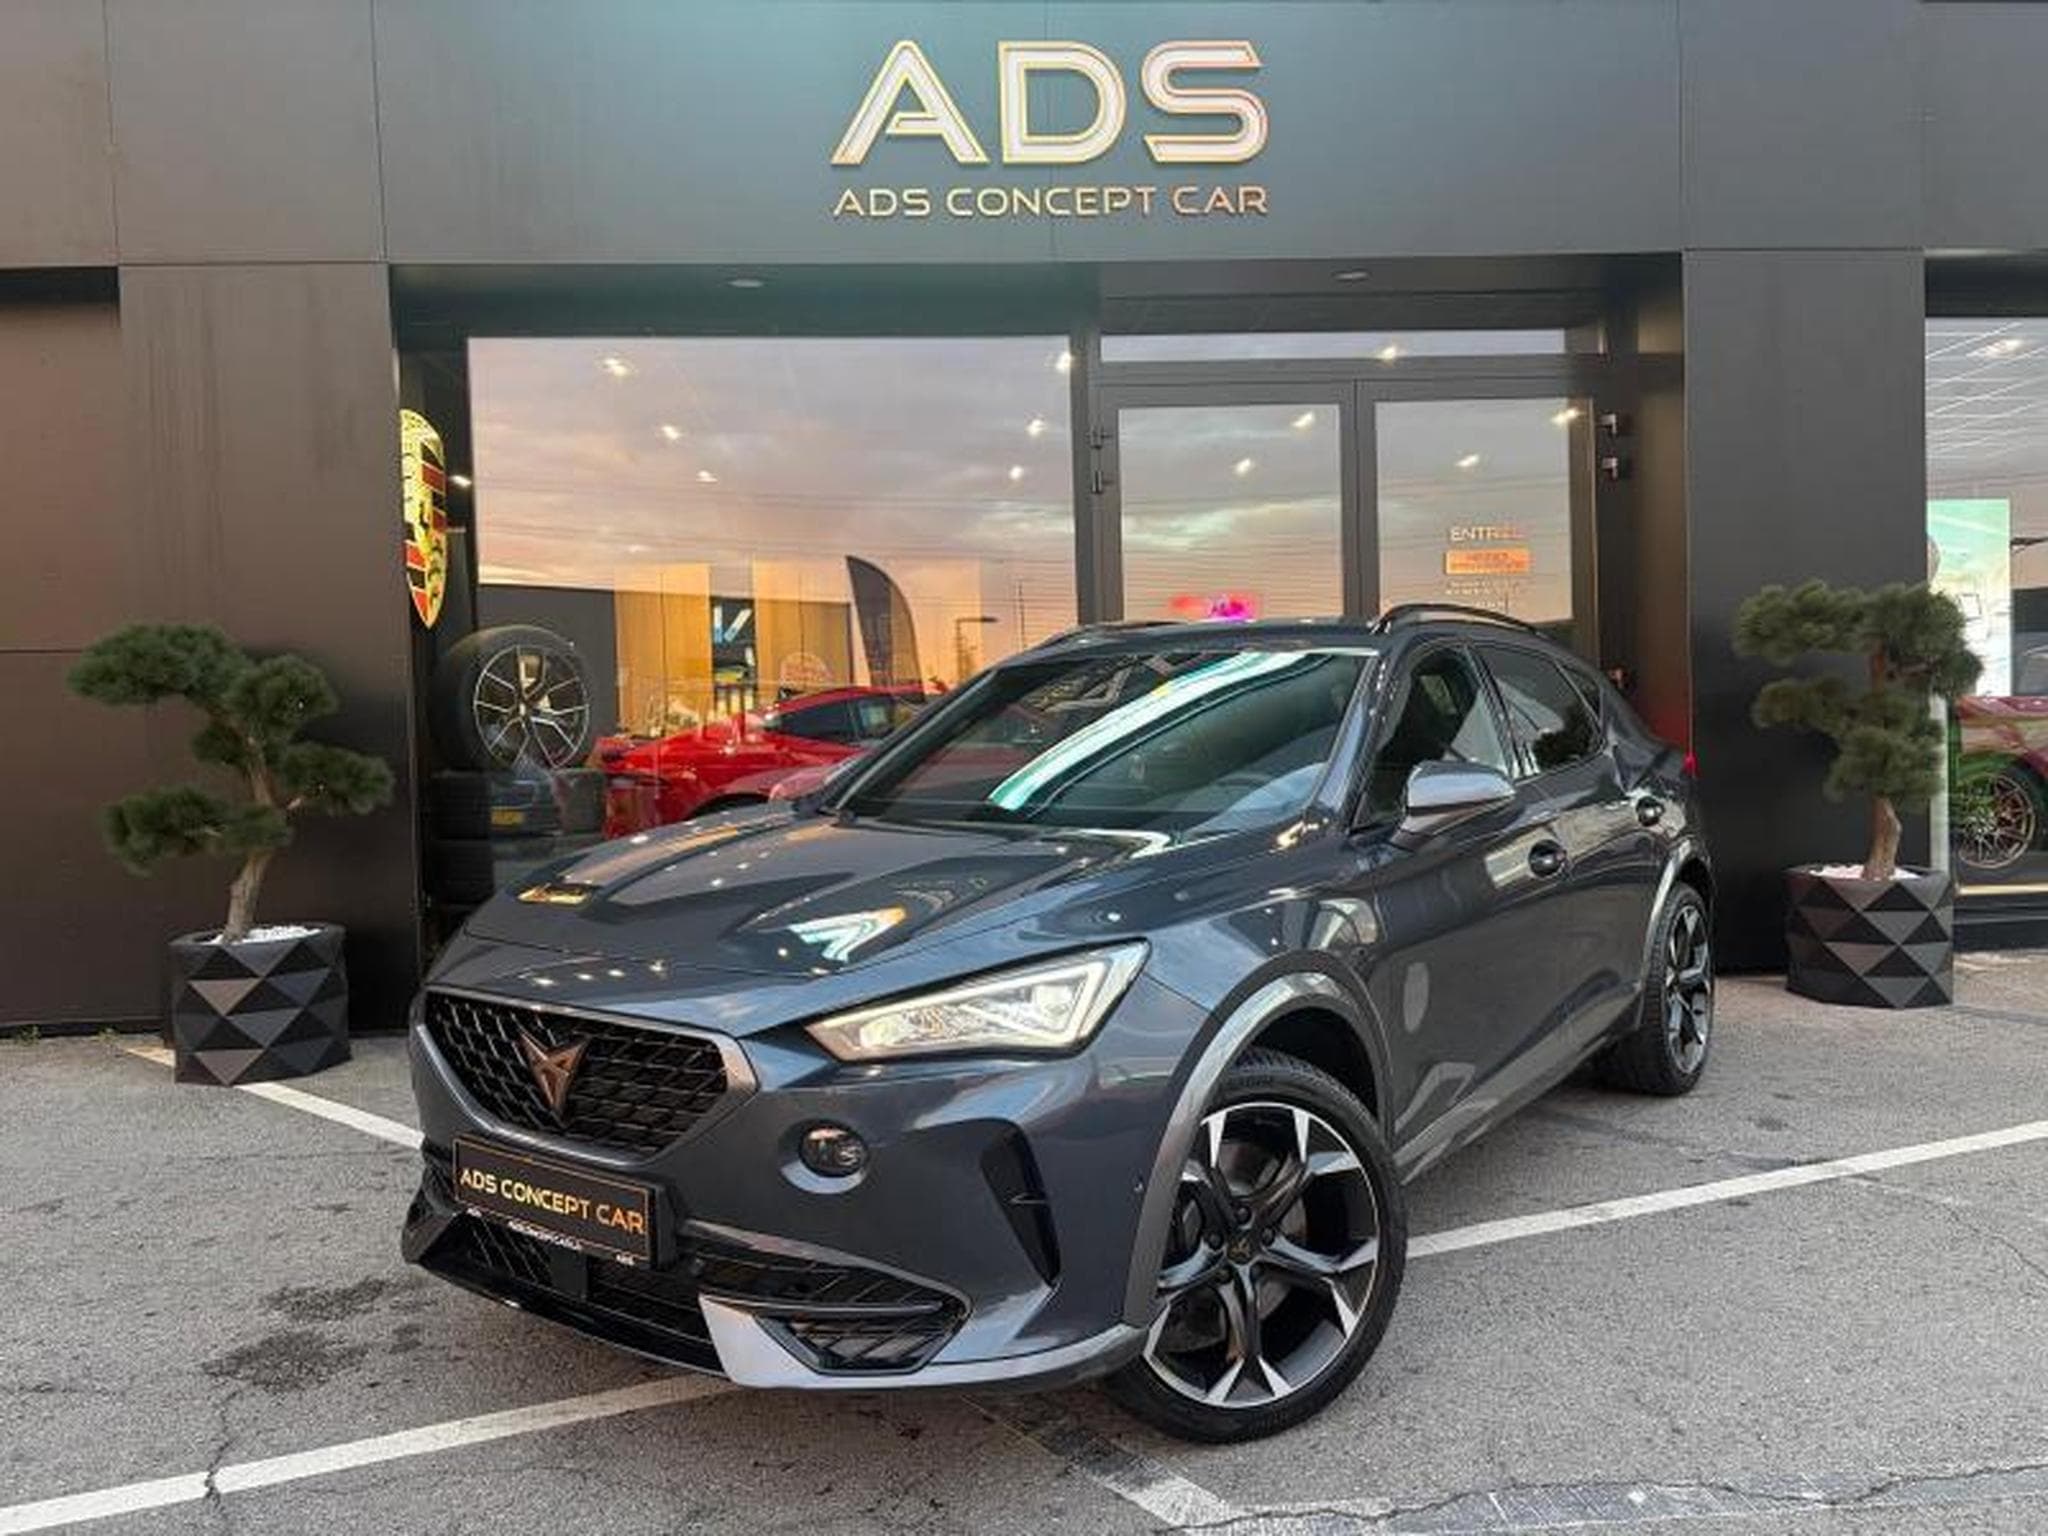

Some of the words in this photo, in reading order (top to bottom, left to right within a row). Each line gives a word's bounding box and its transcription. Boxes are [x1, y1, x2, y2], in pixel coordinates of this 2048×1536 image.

[831, 40, 1268, 164] ADS
[833, 188, 929, 217] ADS
[947, 187, 1156, 216] CONCEPT
[1173, 186, 1268, 215] CAR
[460, 1168, 498, 1194] ADS
[500, 1178, 591, 1219] CONCEPT
[596, 1203, 644, 1235] CAR
